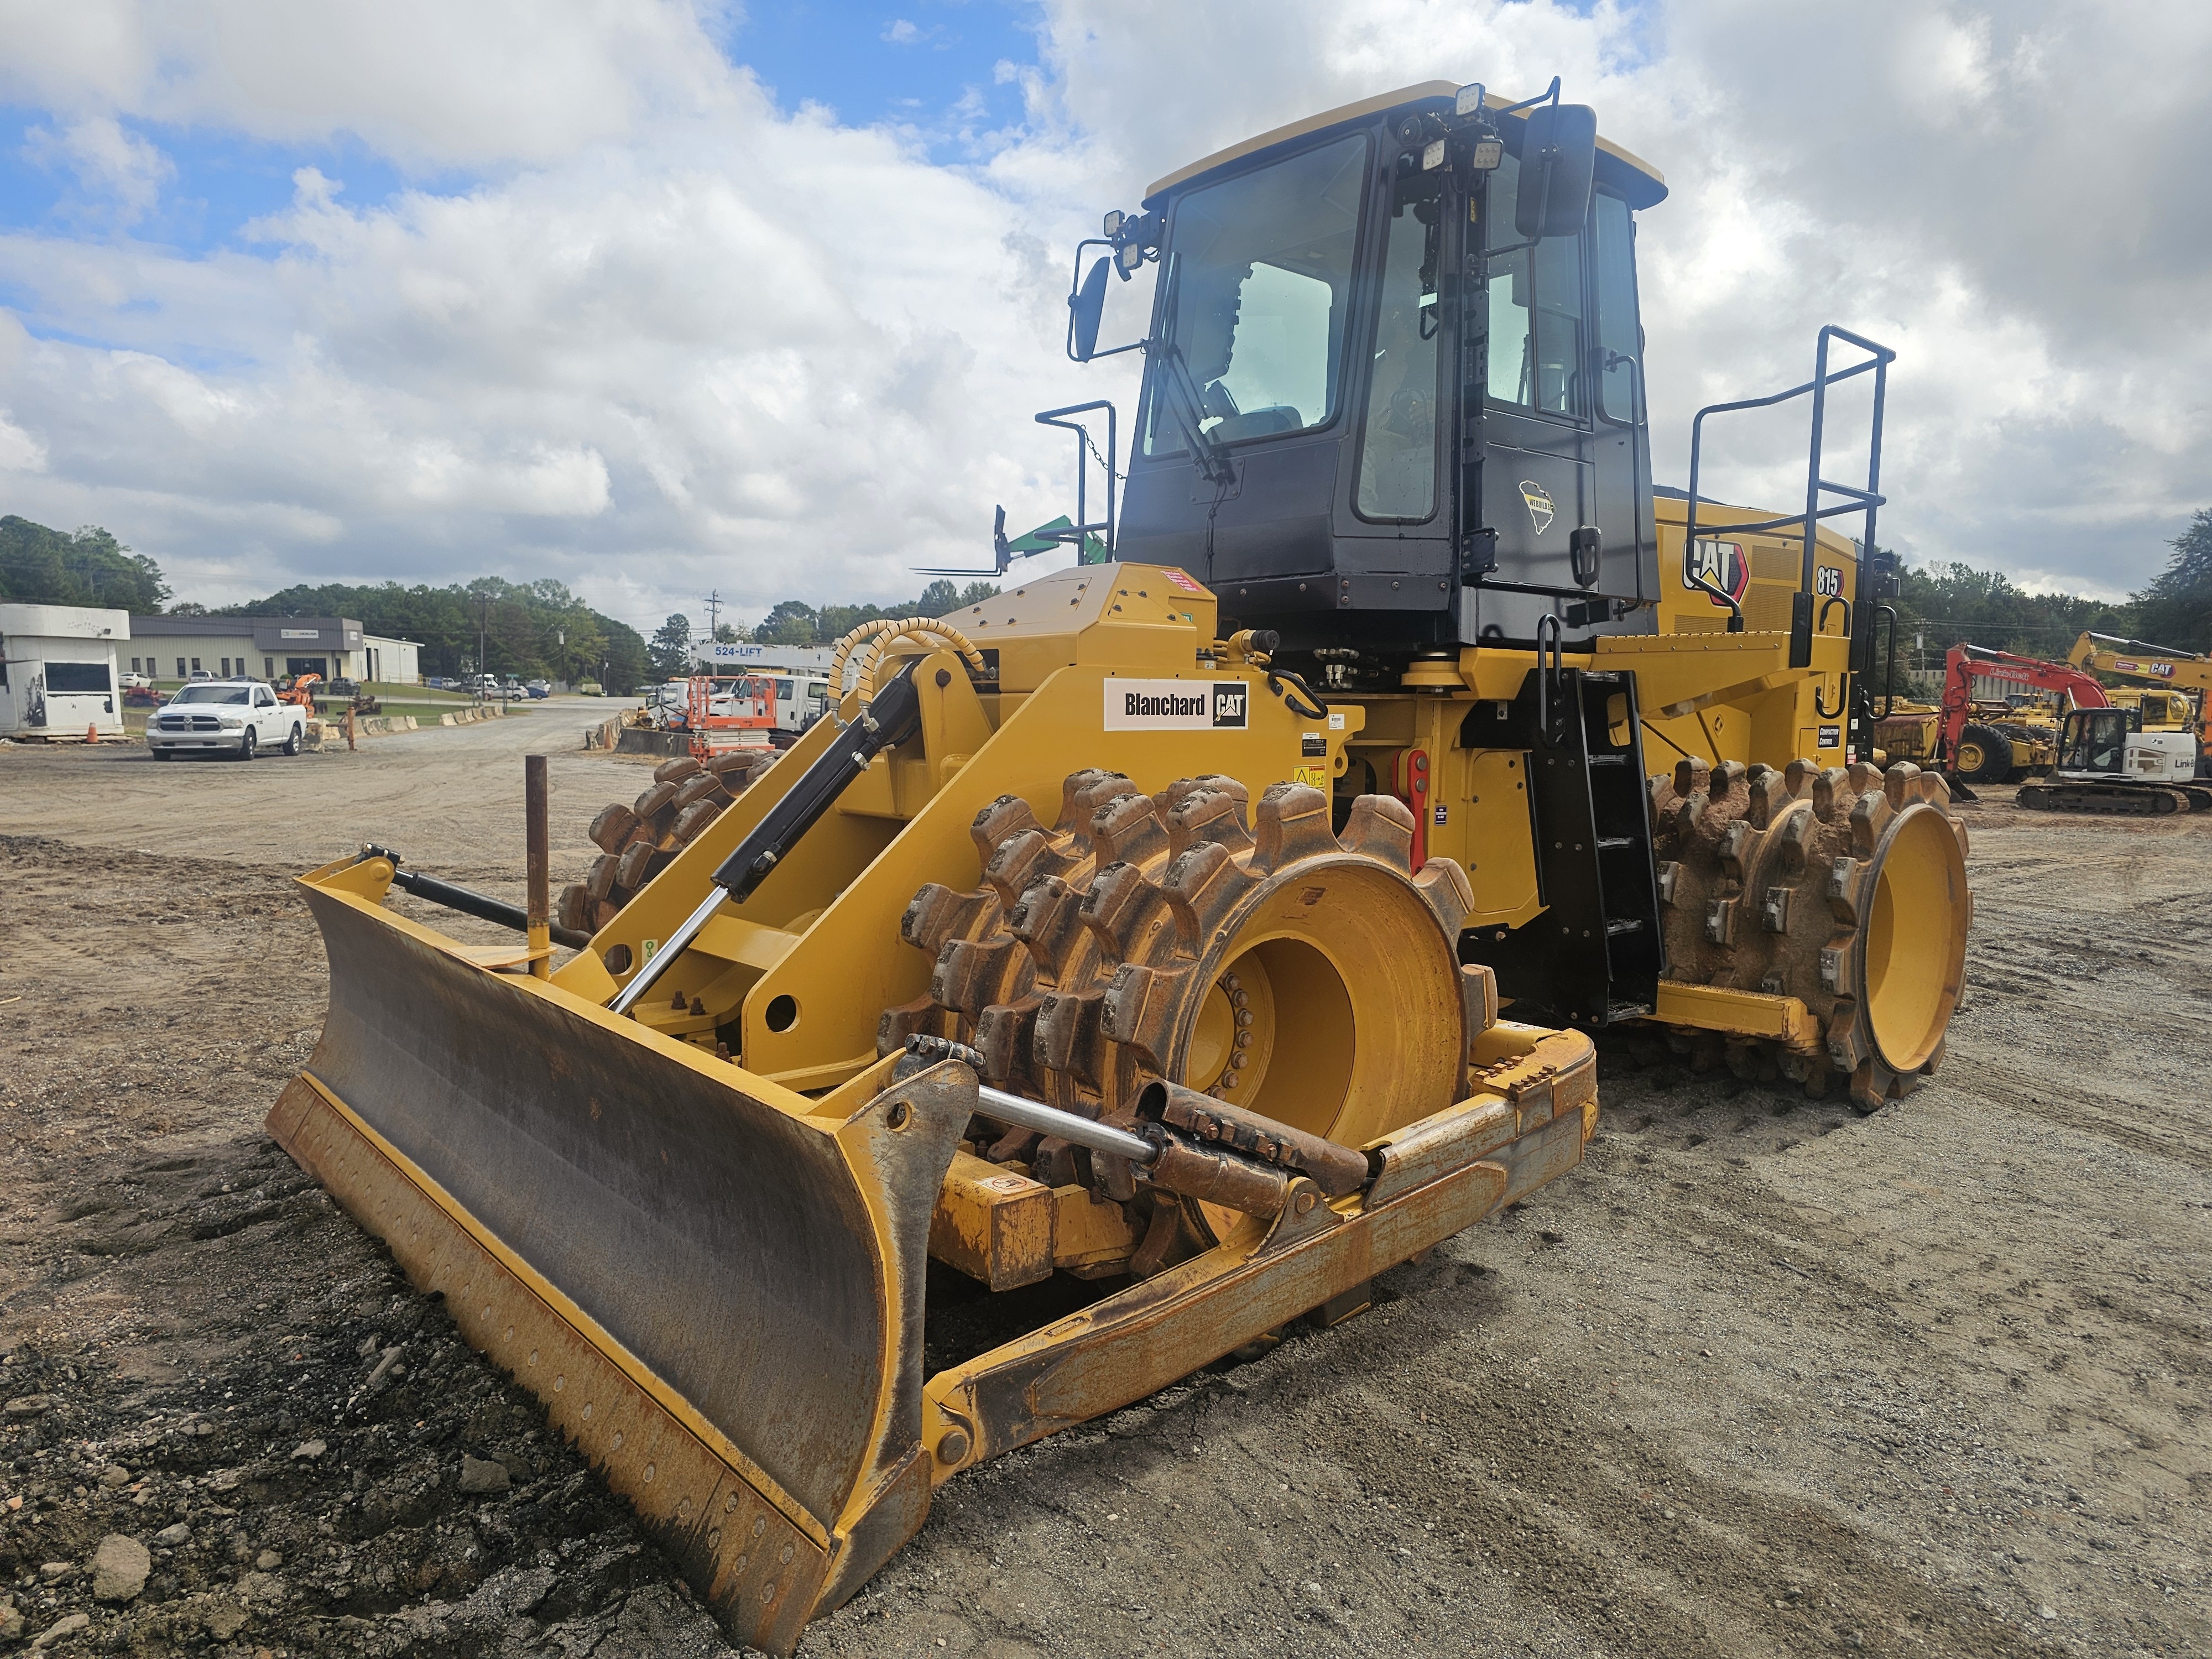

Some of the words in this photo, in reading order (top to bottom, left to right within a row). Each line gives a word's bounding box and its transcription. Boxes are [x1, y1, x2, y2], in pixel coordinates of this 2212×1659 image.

[1529, 498, 1536, 507] WE
[1536, 500, 1547, 509] BUILD
[1683, 539, 1734, 591] CAT
[1817, 567, 1838, 596] 815
[715, 646, 762, 657] 524-LIFT
[1990, 667, 2030, 681] Link-Belt
[2151, 663, 2172, 675] CAT
[1125, 693, 1205, 716] Blanchard
[1216, 694, 1244, 717] CAT
